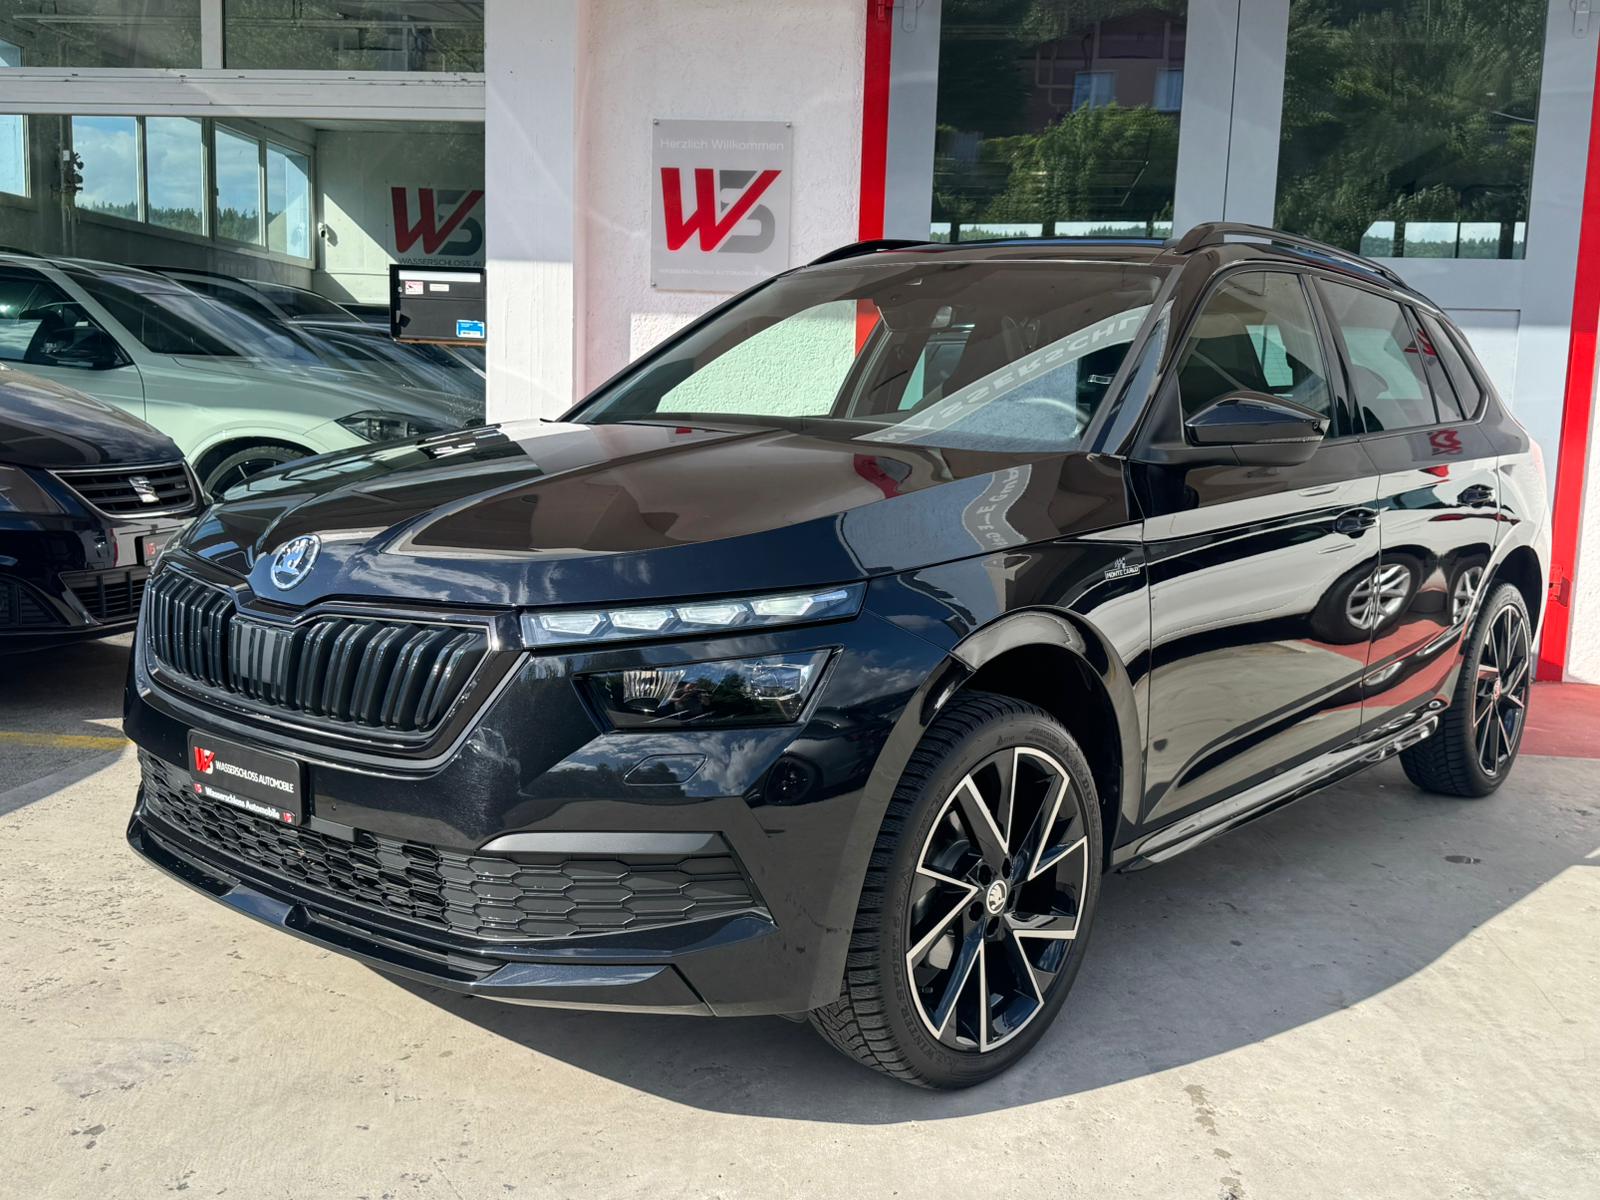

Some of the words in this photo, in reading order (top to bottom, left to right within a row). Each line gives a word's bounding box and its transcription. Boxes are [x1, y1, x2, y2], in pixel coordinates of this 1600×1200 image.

[660, 138, 707, 150] Herzlich
[711, 139, 784, 151] Willkommen
[215, 760, 259, 783] WASSERSCHLOSS
[258, 774, 295, 794] AUTOMOBILE
[205, 785, 246, 808] Wasserschloss
[245, 800, 281, 820] Automobile
